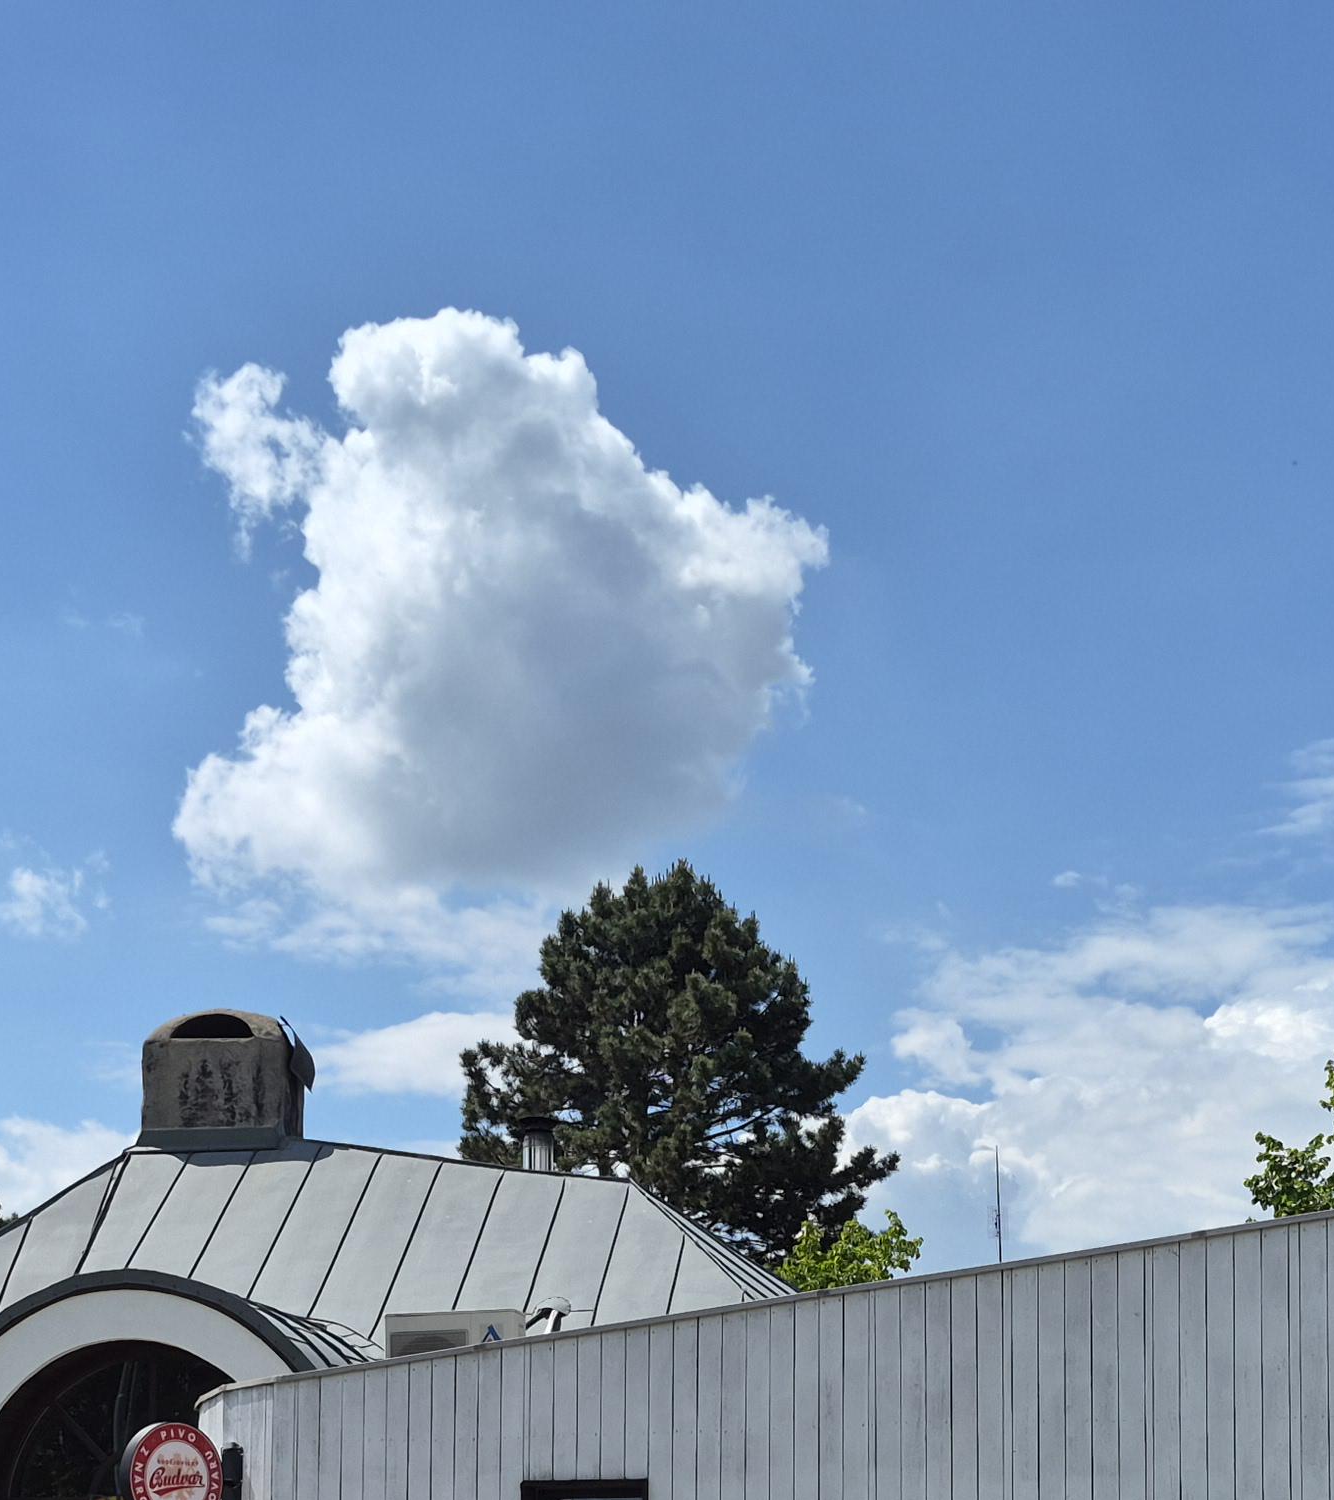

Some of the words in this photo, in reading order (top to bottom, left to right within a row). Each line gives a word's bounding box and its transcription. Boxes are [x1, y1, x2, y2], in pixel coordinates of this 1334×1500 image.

[160, 1428, 196, 1442] PIVO
[140, 1446, 149, 1456] Z
[149, 1466, 205, 1494] Budvar
